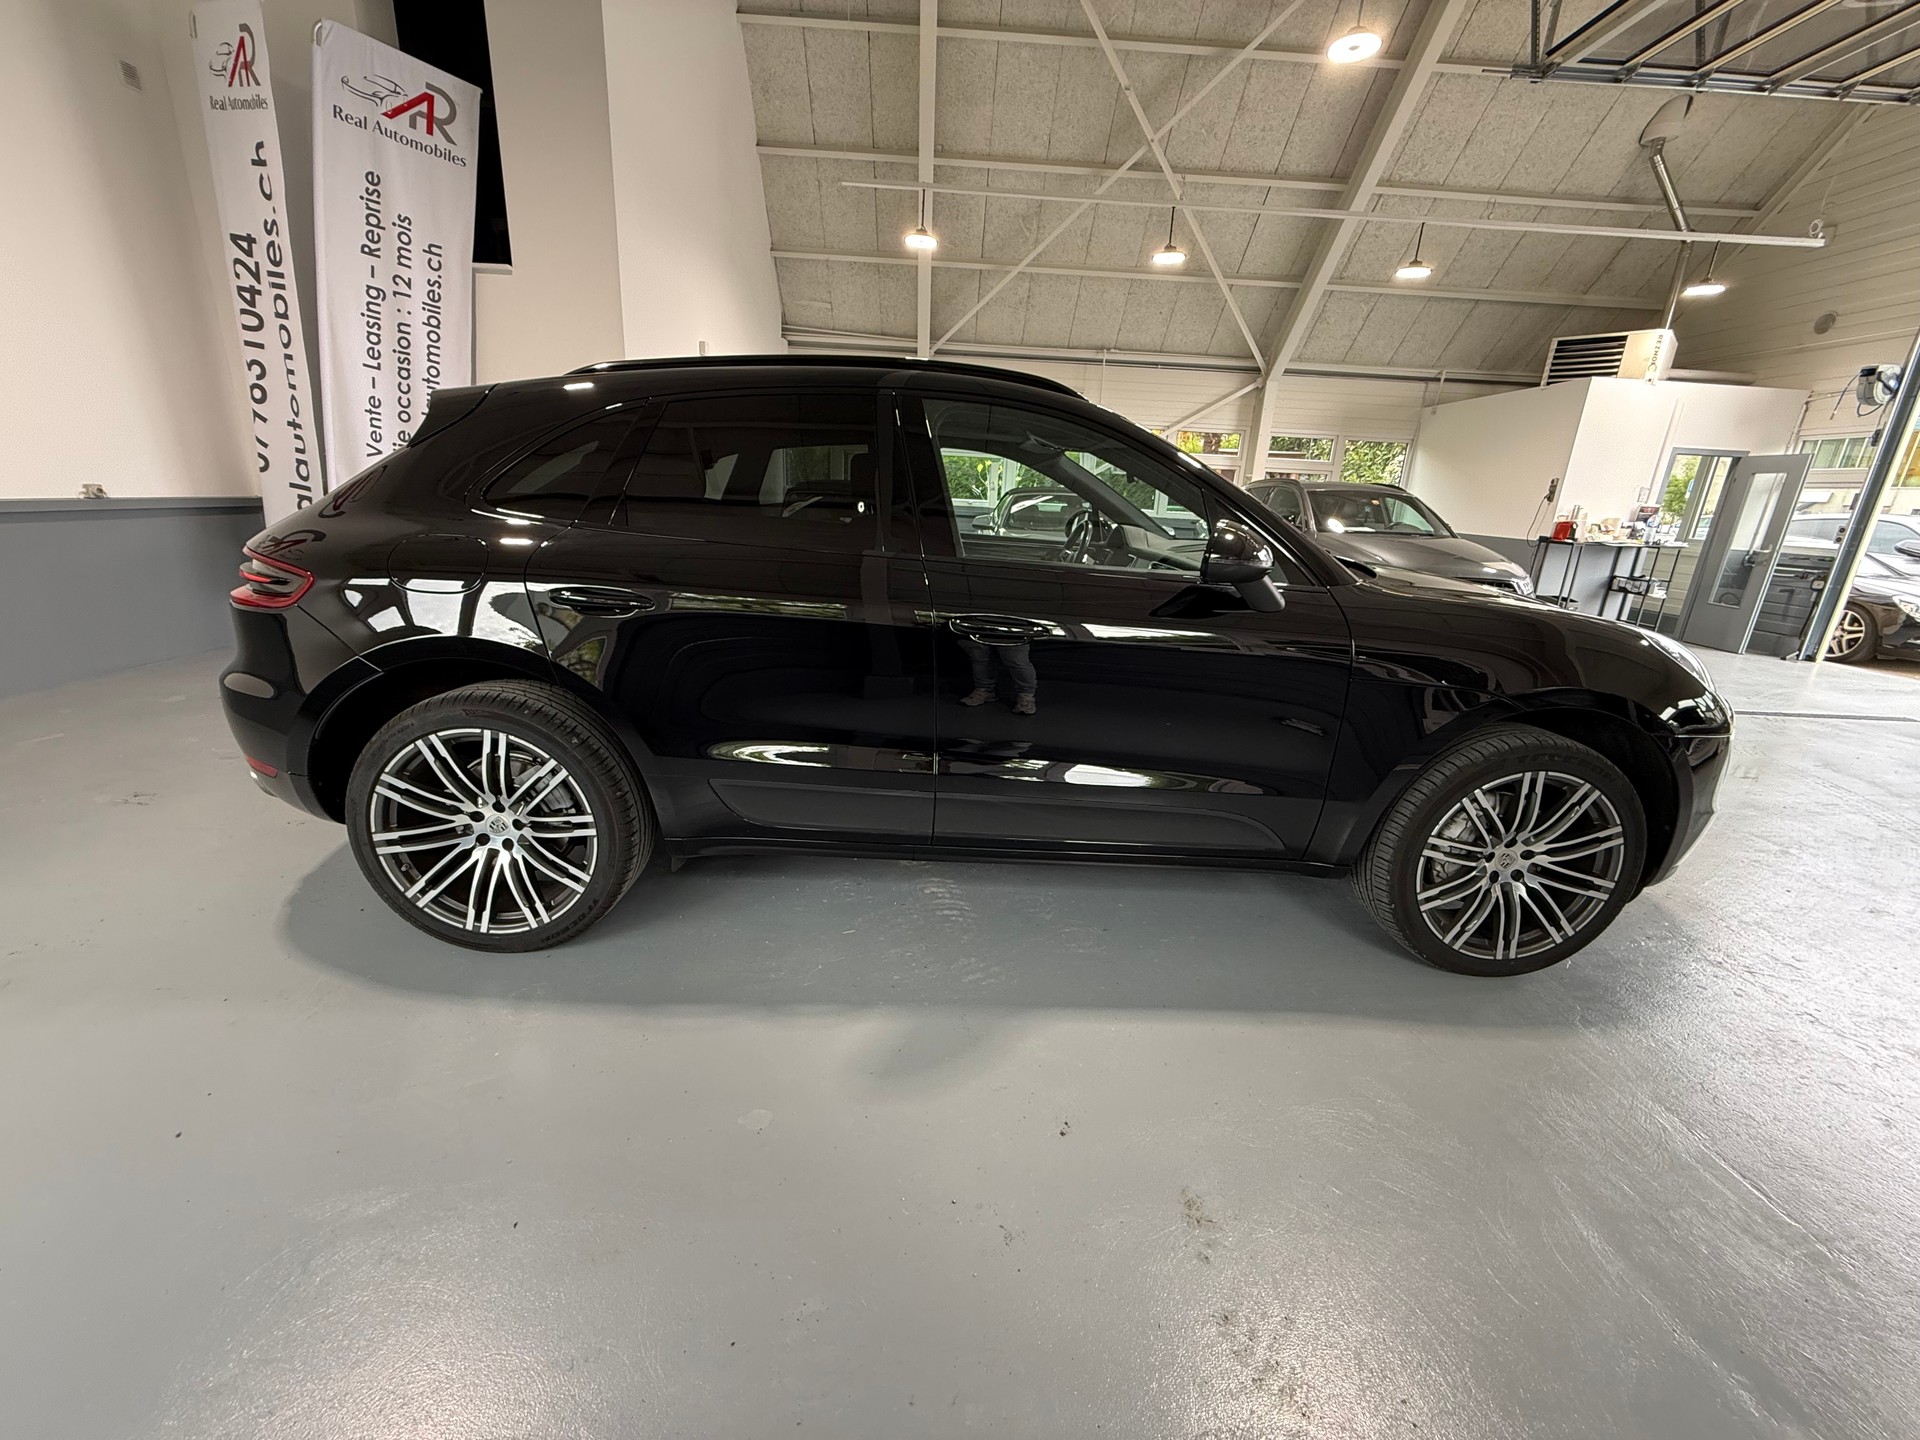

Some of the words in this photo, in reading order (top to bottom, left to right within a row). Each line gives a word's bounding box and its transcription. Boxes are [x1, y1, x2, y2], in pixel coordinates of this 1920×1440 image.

[209, 95, 227, 111] Real
[332, 104, 368, 130] Real
[372, 120, 467, 168] Automobiles
[359, 170, 387, 259] Reprise
[391, 213, 412, 269] mois
[391, 274, 412, 298] 12
[360, 284, 387, 371] Leasing
[392, 322, 412, 423] occasion
[364, 395, 383, 457] Vente
